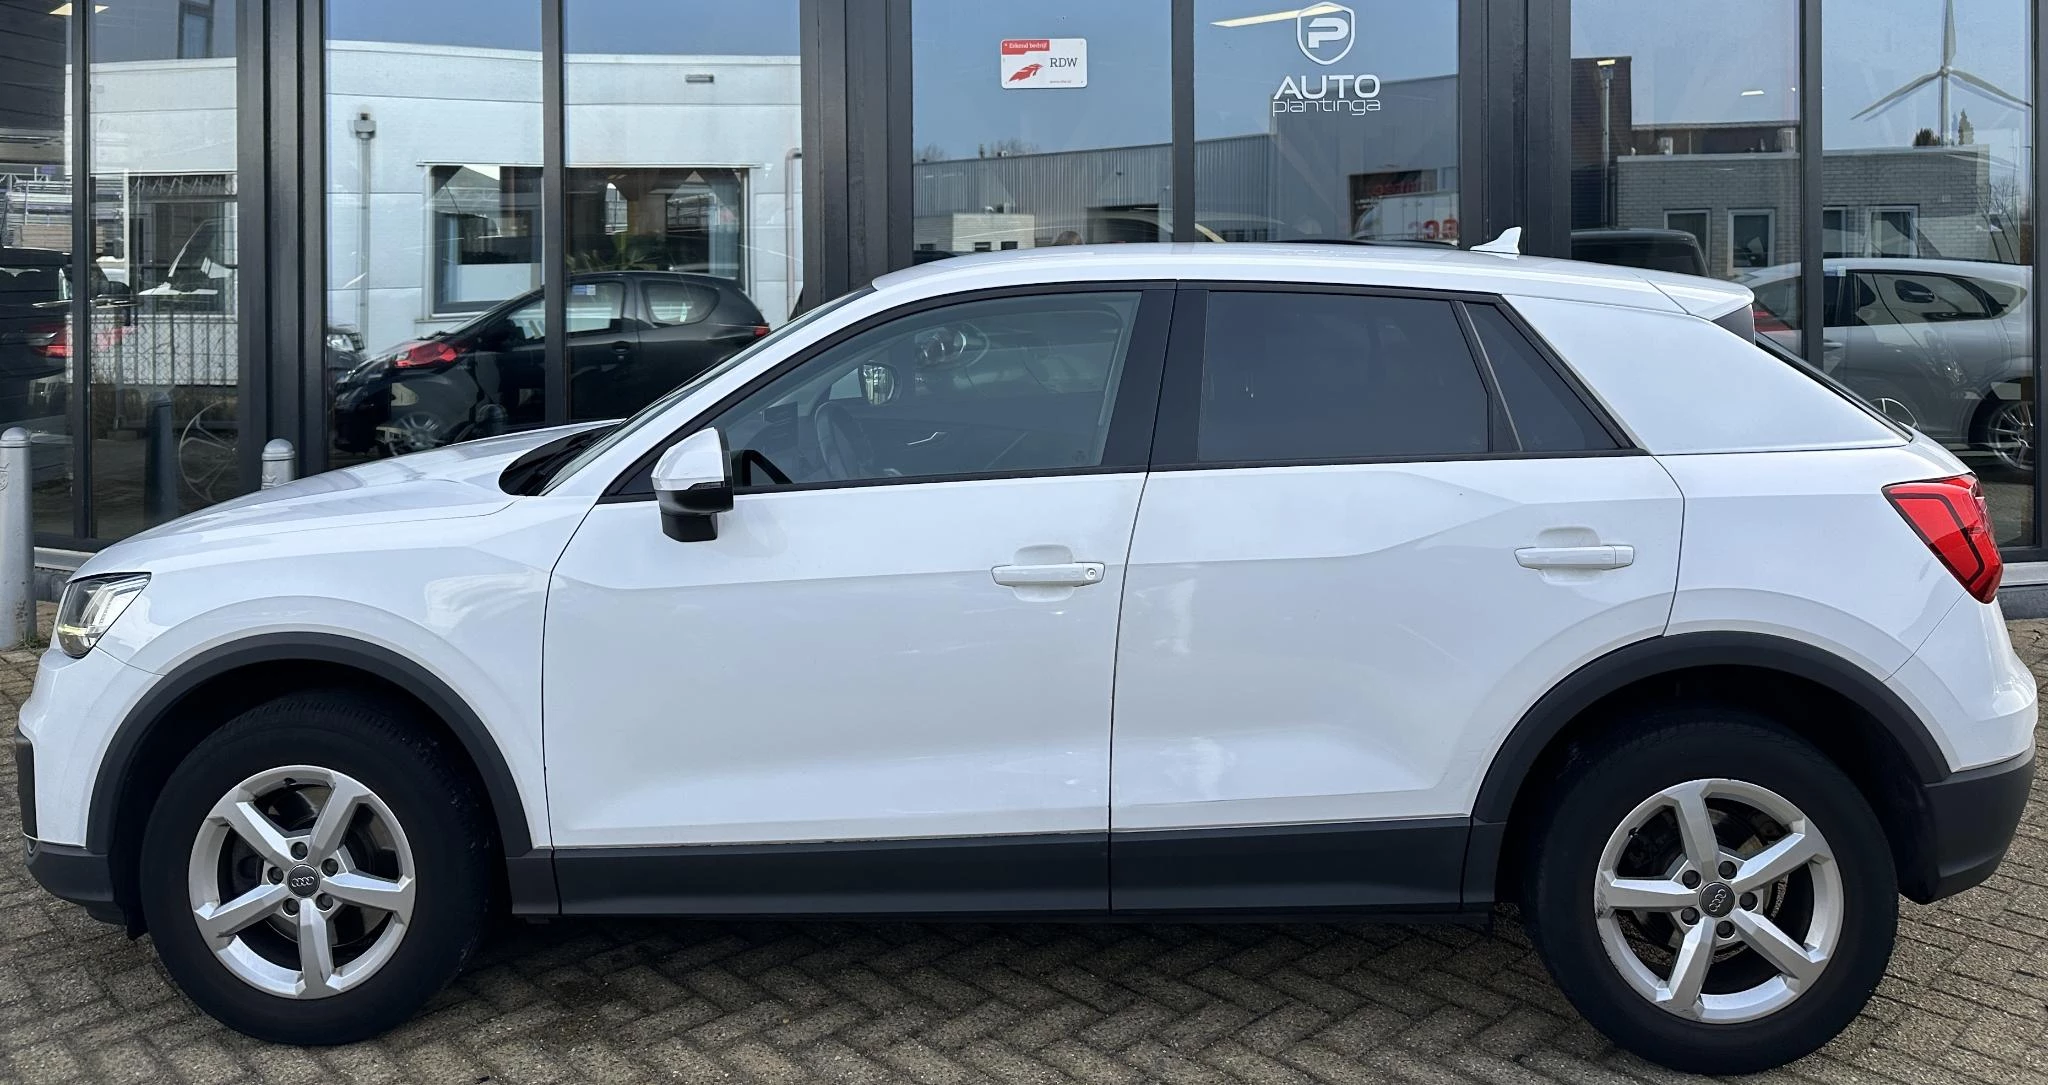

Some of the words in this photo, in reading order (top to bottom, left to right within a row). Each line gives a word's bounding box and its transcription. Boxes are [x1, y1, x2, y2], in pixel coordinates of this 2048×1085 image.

[1308, 17, 1349, 49] P
[1049, 57, 1078, 68] RDW
[1273, 74, 1381, 99] AUTO
[1272, 98, 1381, 117] plantinga
